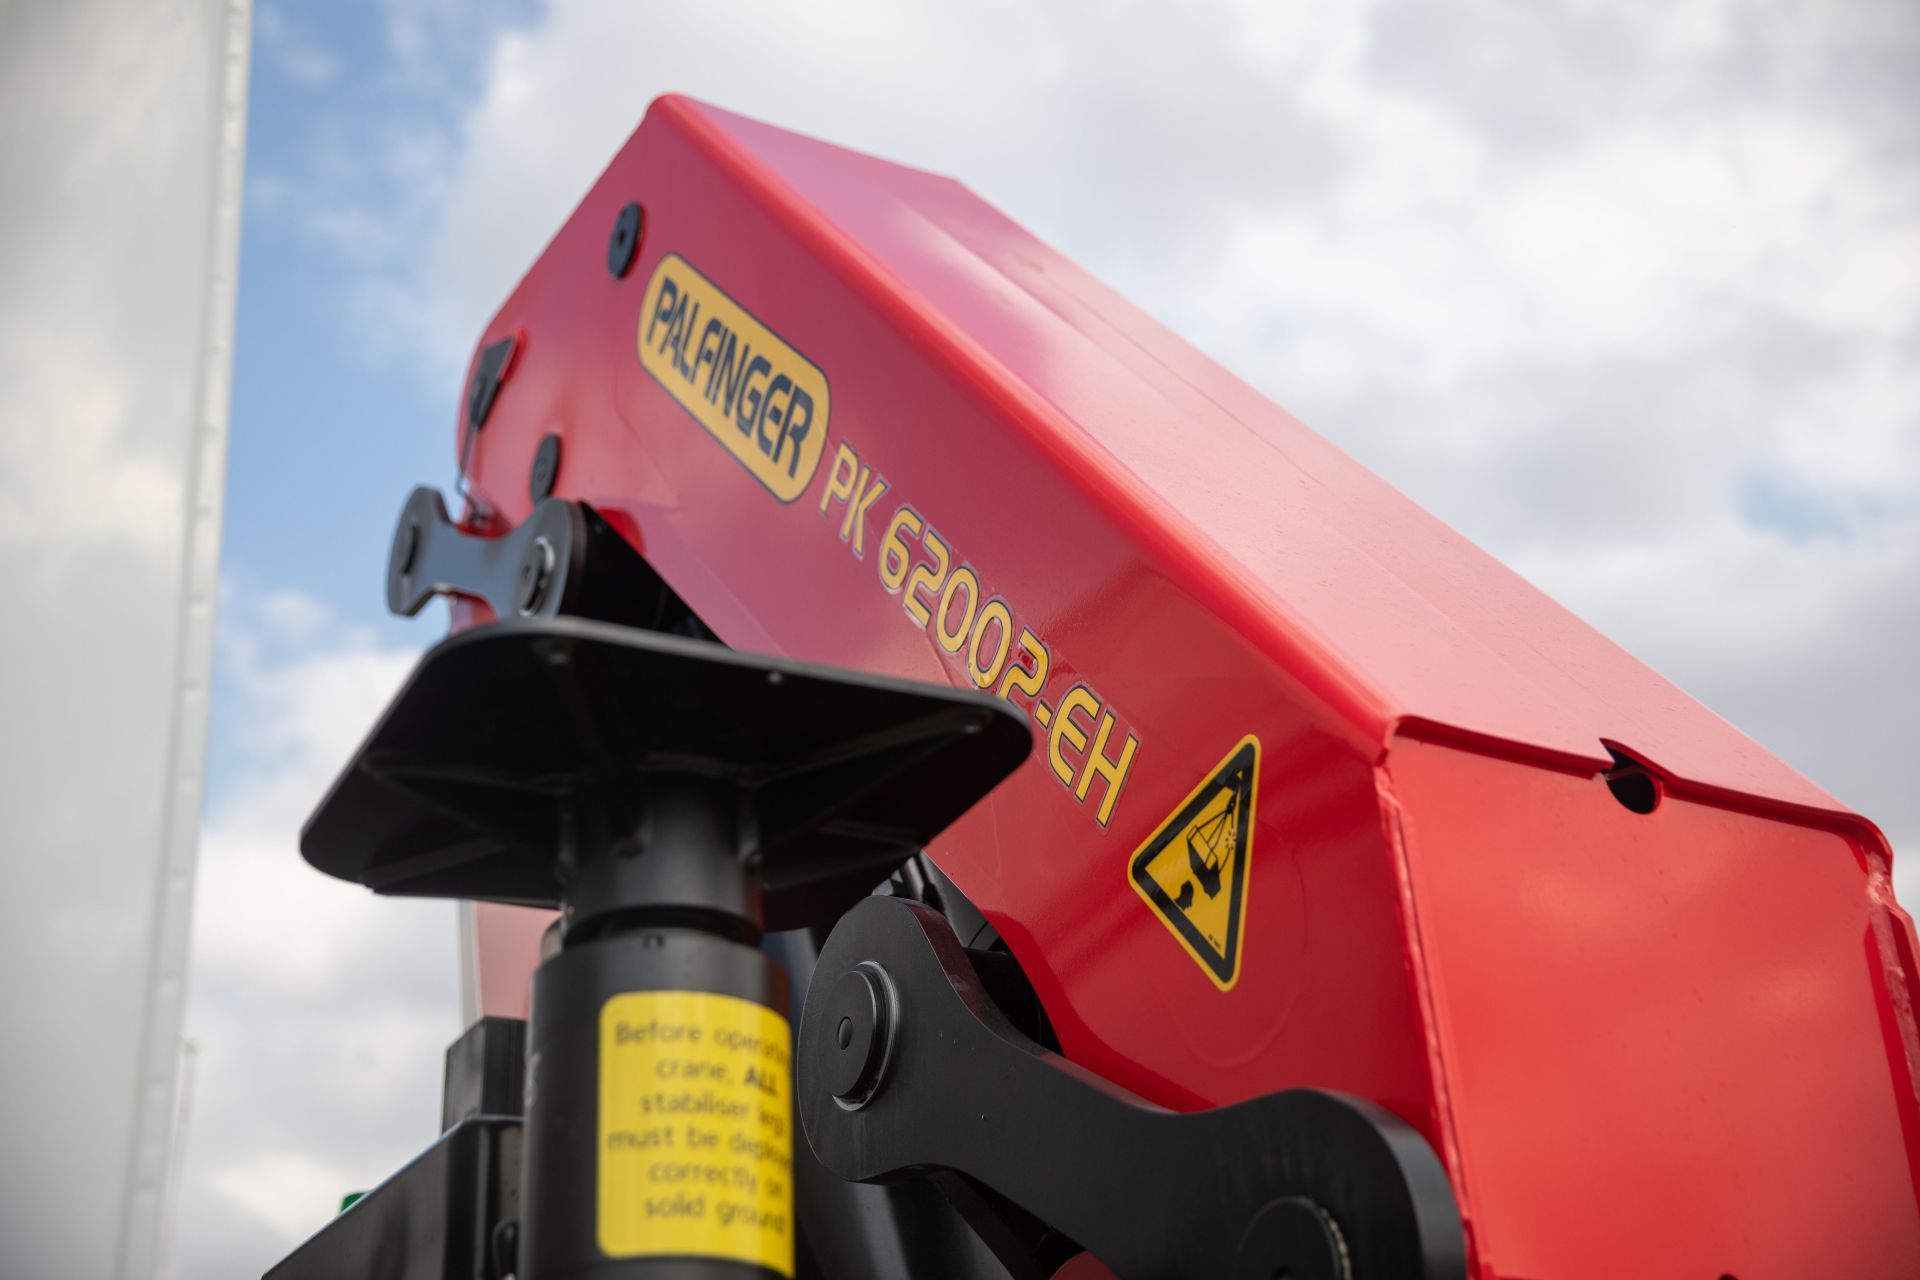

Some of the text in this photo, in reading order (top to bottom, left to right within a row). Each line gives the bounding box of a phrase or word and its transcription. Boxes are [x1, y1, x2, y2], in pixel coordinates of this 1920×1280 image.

[646, 276, 814, 479] PALFINGER
[820, 441, 1139, 827] PK 62002-EH
[614, 1019, 703, 1046] Before
[744, 1066, 779, 1098] ALL
[641, 1090, 748, 1117] stabiliser
[607, 1127, 674, 1151] must
[686, 1124, 719, 1149] be
[648, 1160, 757, 1195] correctly
[643, 1192, 786, 1236] solid ground
